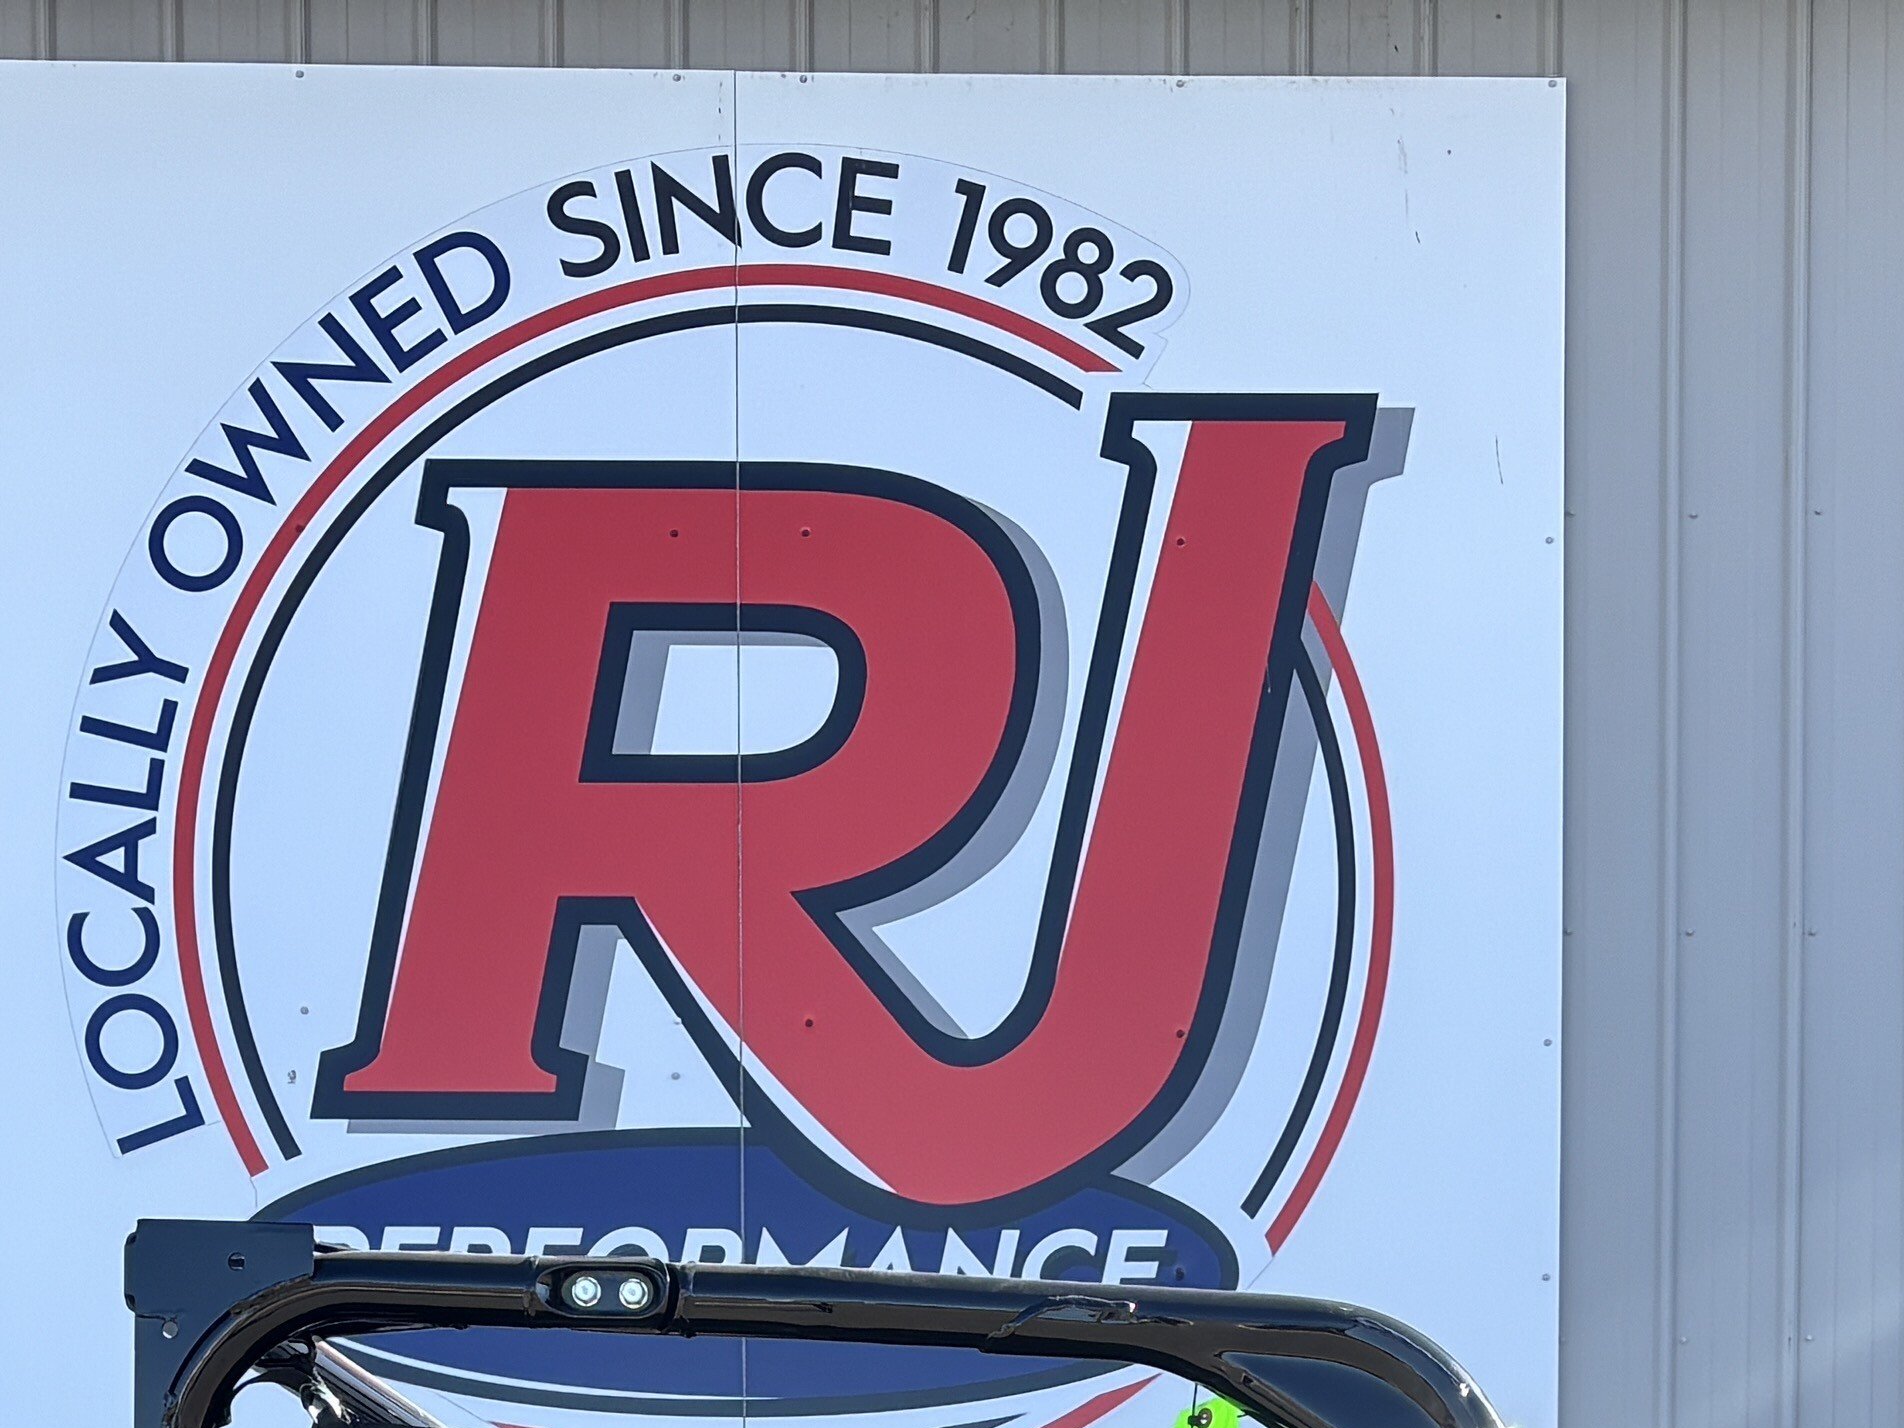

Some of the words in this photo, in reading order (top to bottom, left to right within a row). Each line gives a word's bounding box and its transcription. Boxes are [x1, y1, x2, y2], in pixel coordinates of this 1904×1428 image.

[62, 608, 206, 1155] LOCALLY
[149, 230, 510, 592] OWNED
[546, 152, 902, 279] SINCE
[947, 179, 1176, 360] 1982
[311, 392, 1380, 1214] RJ
[313, 1225, 1168, 1285] RMANCE
